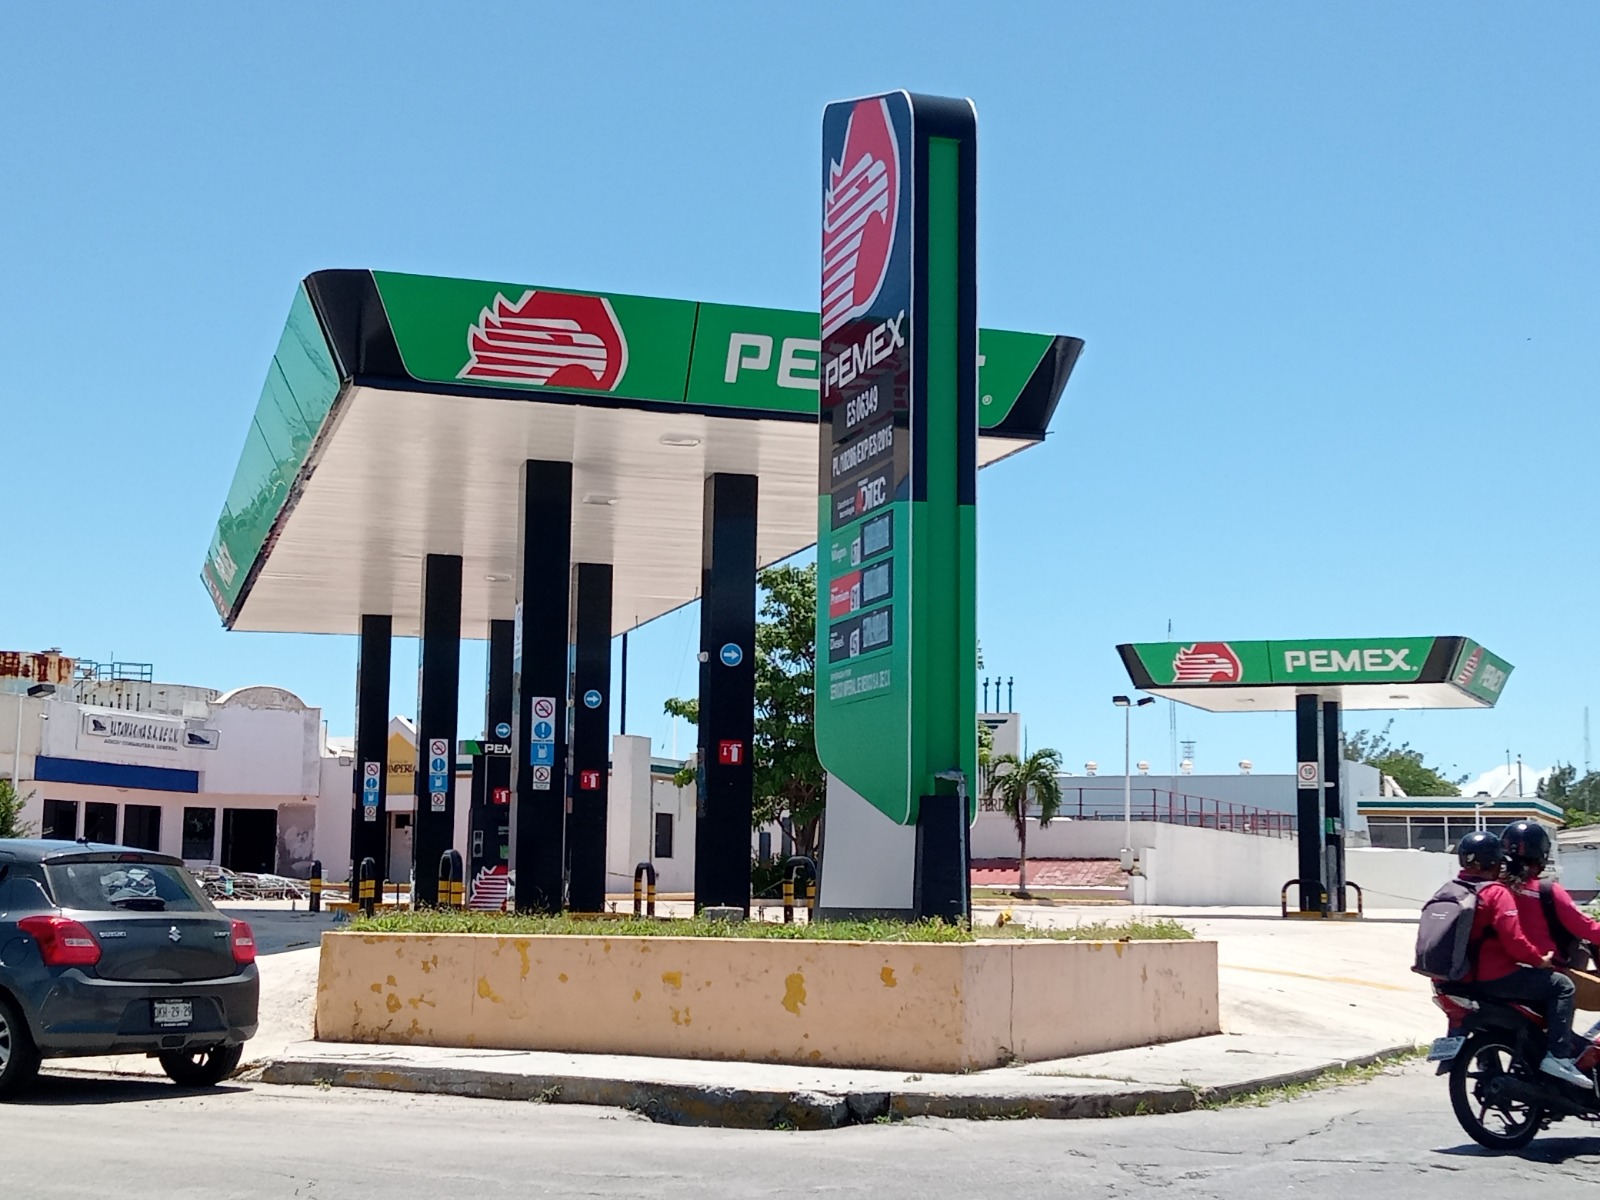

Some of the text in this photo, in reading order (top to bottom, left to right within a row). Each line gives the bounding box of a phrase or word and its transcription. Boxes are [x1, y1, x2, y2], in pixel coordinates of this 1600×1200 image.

[825, 309, 906, 398] PEMEX
[846, 399, 857, 428] ES
[1284, 648, 1411, 673] PEMEX
[484, 743, 513, 754] PEM
[99, 930, 127, 938] SUZUKI
